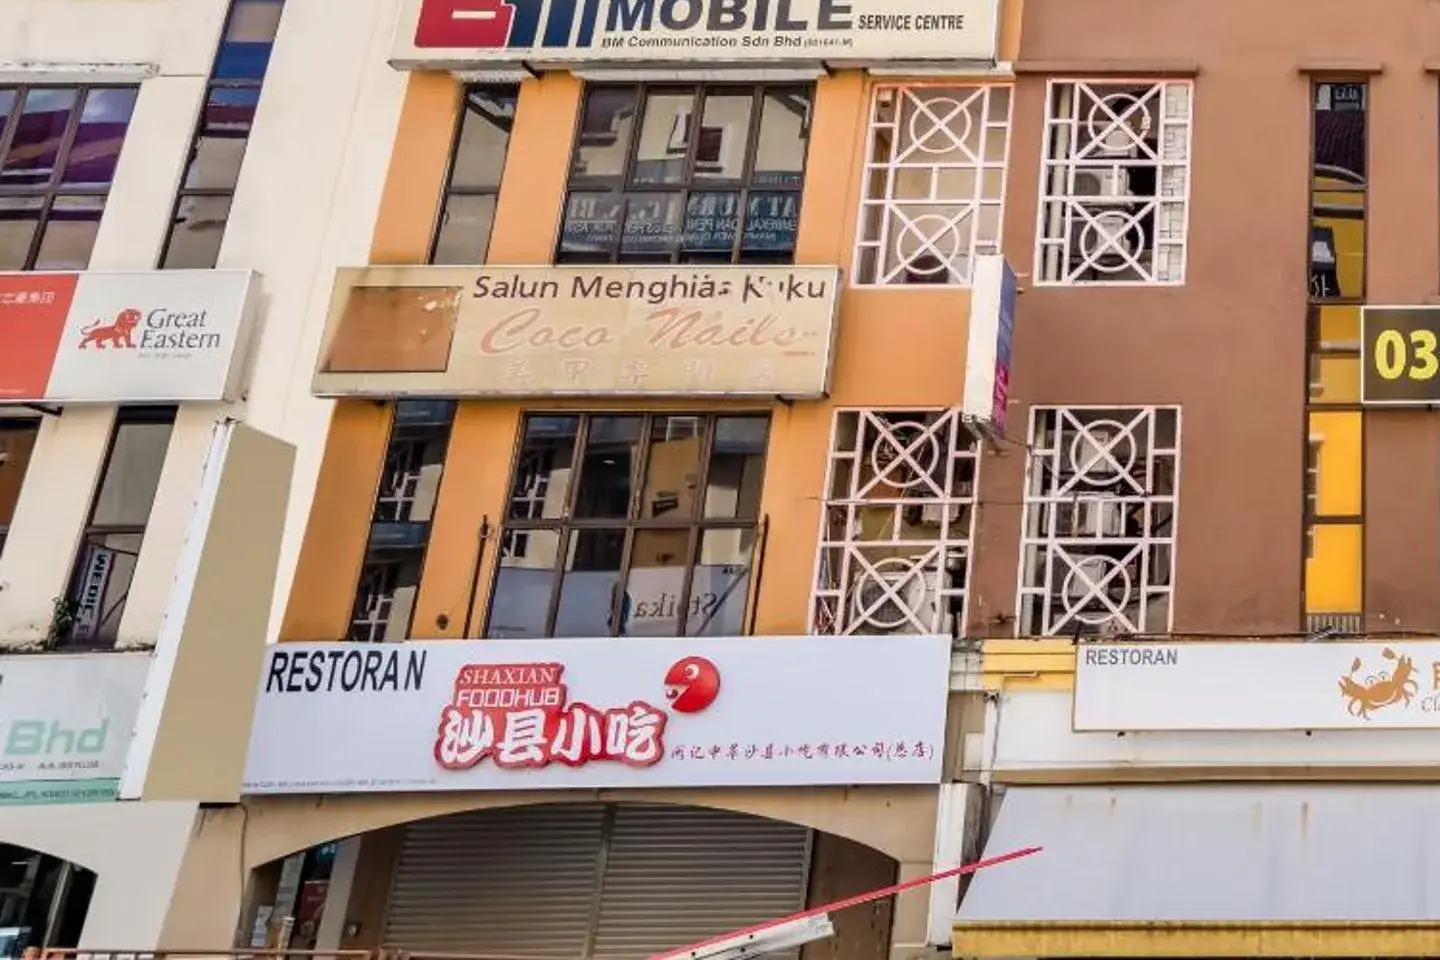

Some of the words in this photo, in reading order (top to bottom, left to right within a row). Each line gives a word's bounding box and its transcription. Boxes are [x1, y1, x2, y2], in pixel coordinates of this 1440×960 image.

[858, 14, 911, 30] SERVICE
[915, 14, 964, 30] CENTRE
[602, 38, 624, 48] BM
[627, 36, 737, 48] Communication
[742, 36, 769, 48] Sdn
[774, 35, 801, 48] Bhd
[473, 275, 559, 299] Salun
[147, 308, 207, 329] Great
[139, 330, 221, 349] Eastern
[480, 308, 609, 355] Coco
[645, 307, 804, 348] Nails
[1086, 648, 1178, 665] RESTORAN
[266, 650, 427, 693] RESTORAN
[460, 667, 556, 686] SHAXIAN
[456, 688, 560, 708] FOODHUB
[4, 716, 110, 756] Bhd
[440, 707, 659, 763] 沙县小吃
